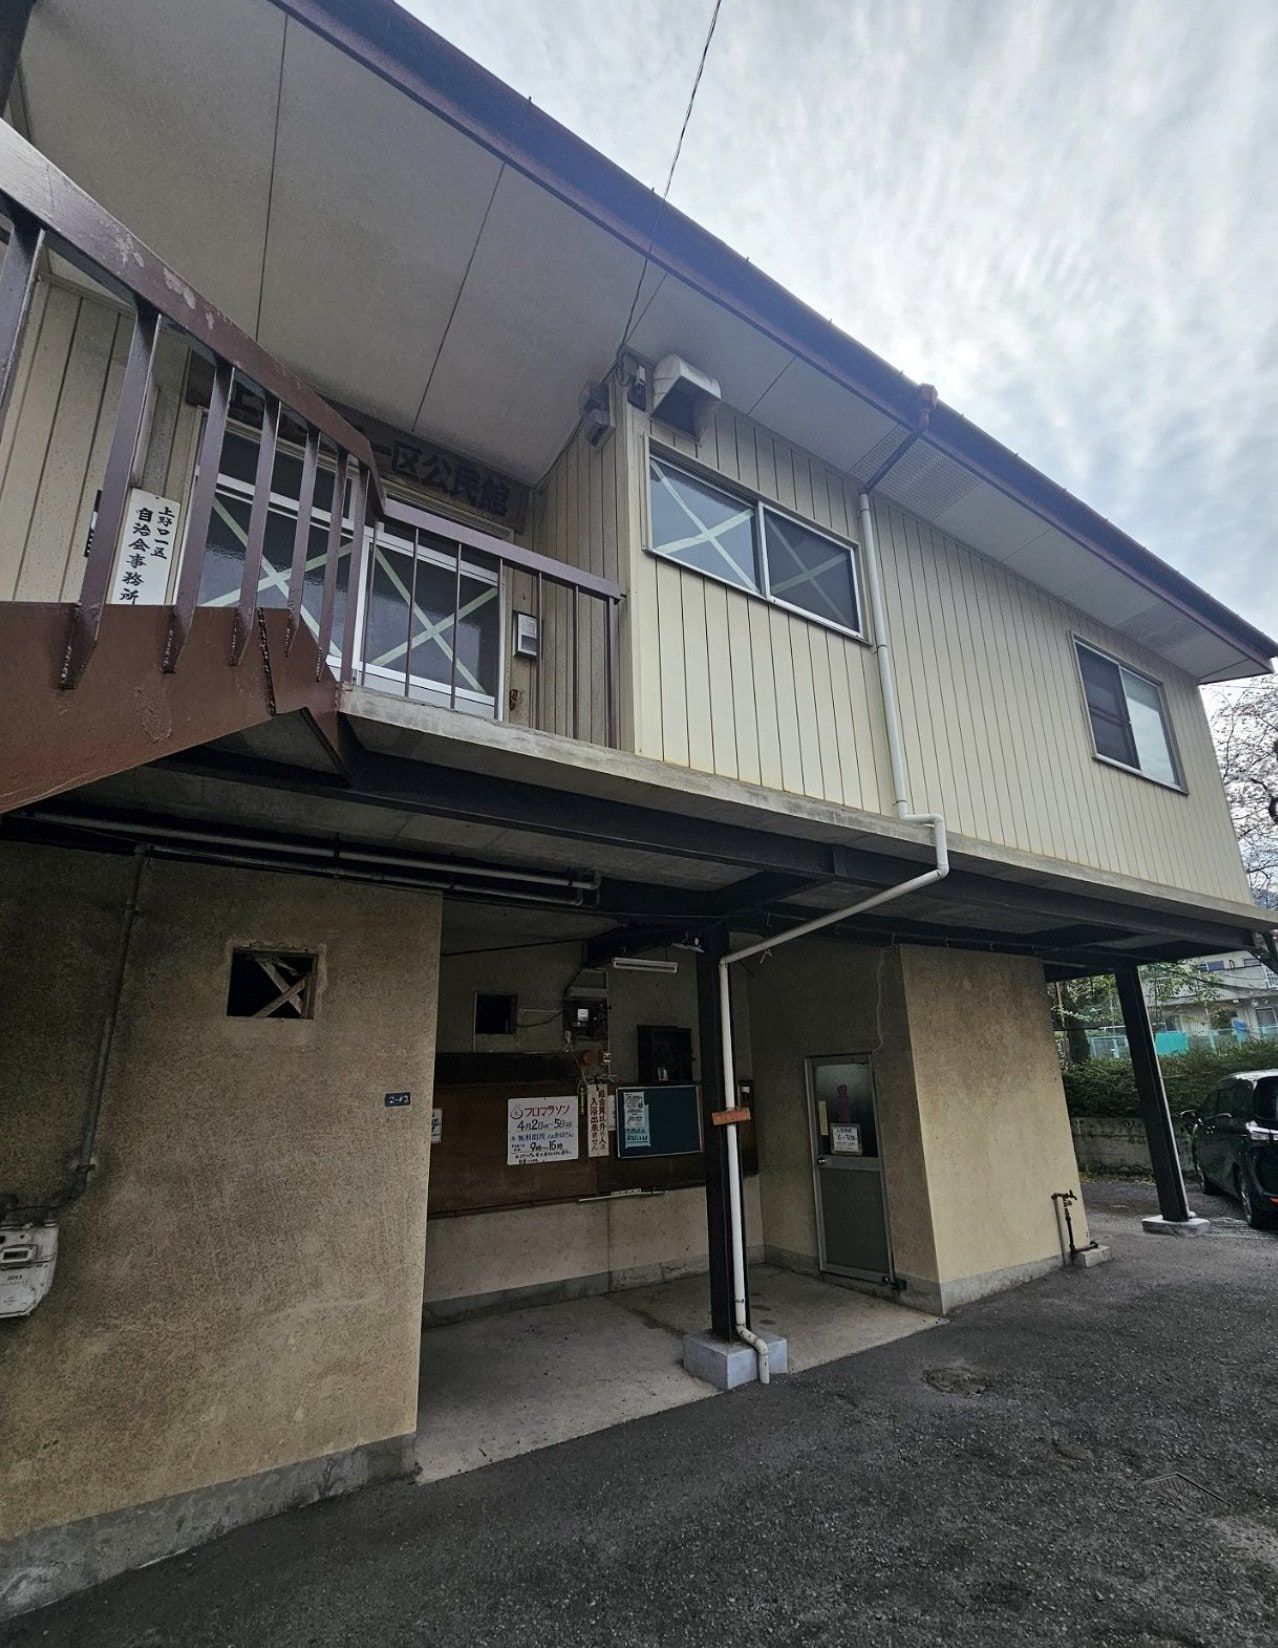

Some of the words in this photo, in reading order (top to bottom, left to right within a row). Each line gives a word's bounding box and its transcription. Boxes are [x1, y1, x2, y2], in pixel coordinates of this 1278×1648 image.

[119, 507, 154, 604] 自治会事務所
